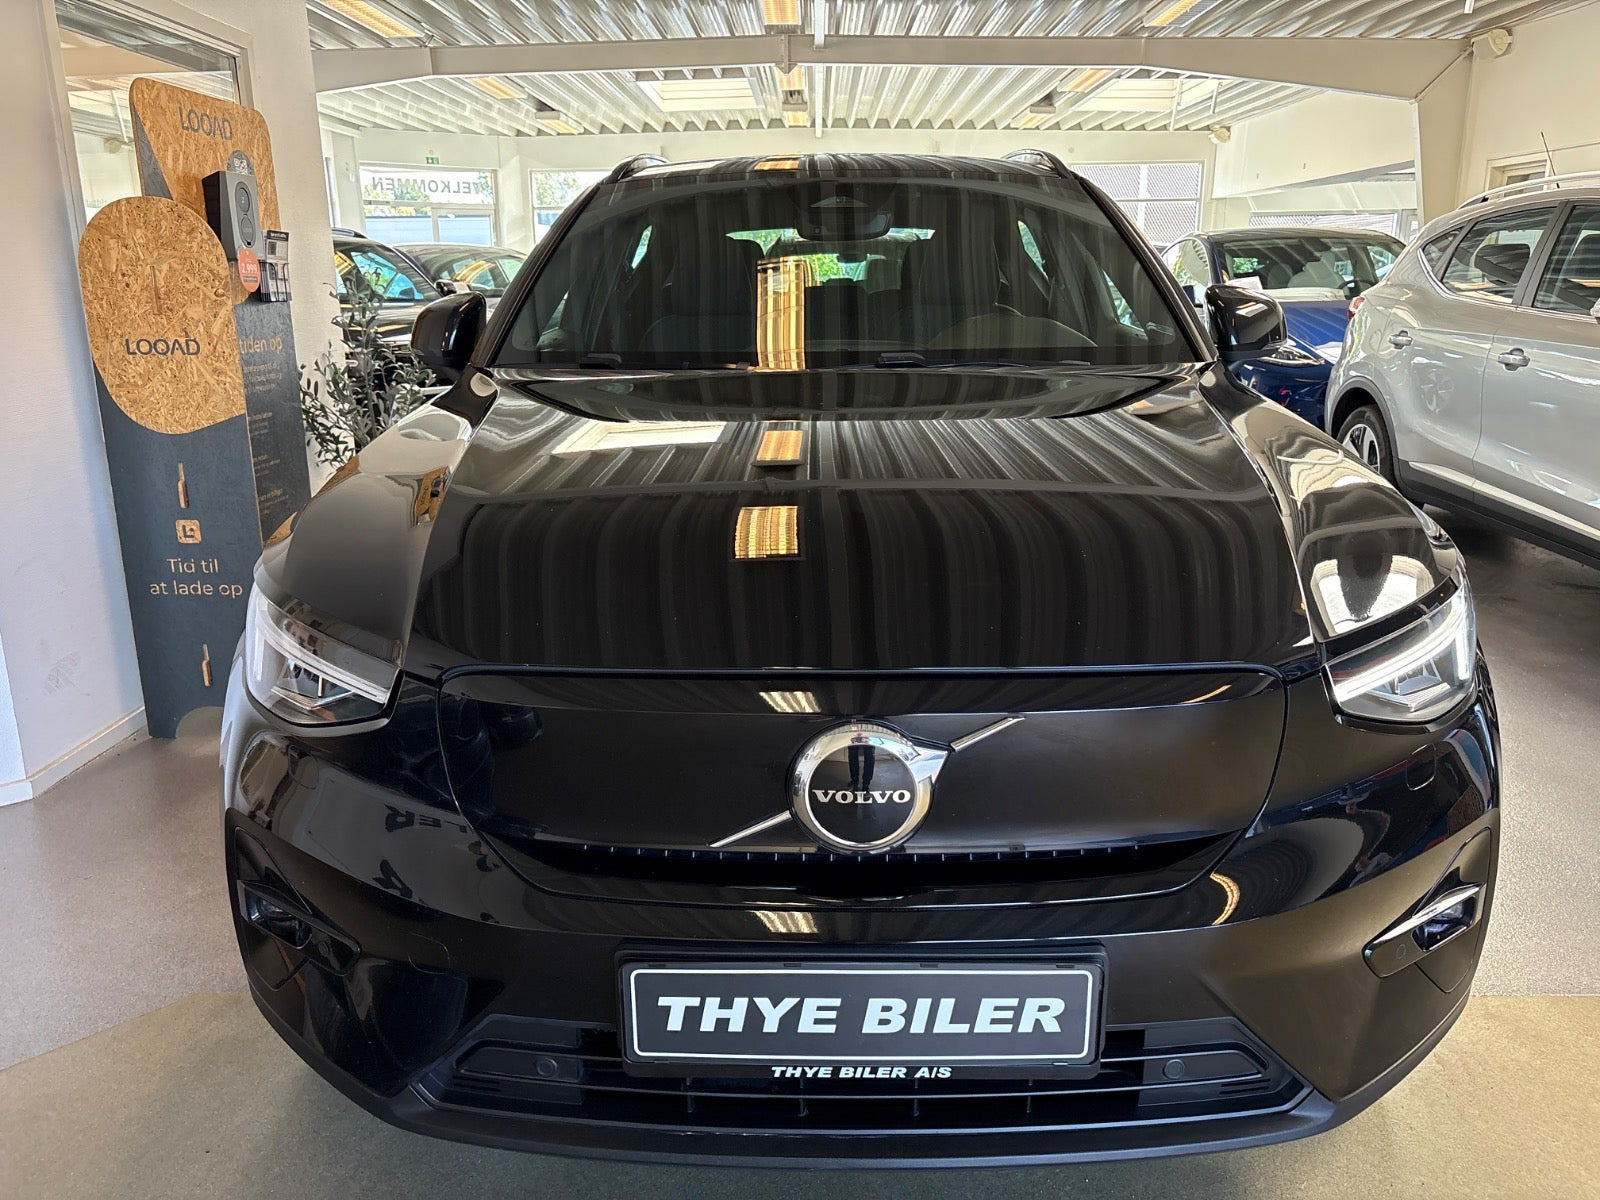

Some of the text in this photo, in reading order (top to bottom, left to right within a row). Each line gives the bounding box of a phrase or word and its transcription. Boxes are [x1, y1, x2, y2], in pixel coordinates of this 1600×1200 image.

[179, 106, 233, 140] LOOAD
[124, 338, 201, 356] LOOAD
[269, 335, 283, 354] op
[166, 558, 218, 574] Tid til
[149, 579, 243, 599] at lade op
[812, 789, 911, 804] VOLVO
[657, 996, 1066, 1034] THYE BILER
[771, 1066, 952, 1079] THYE BILER A/S
